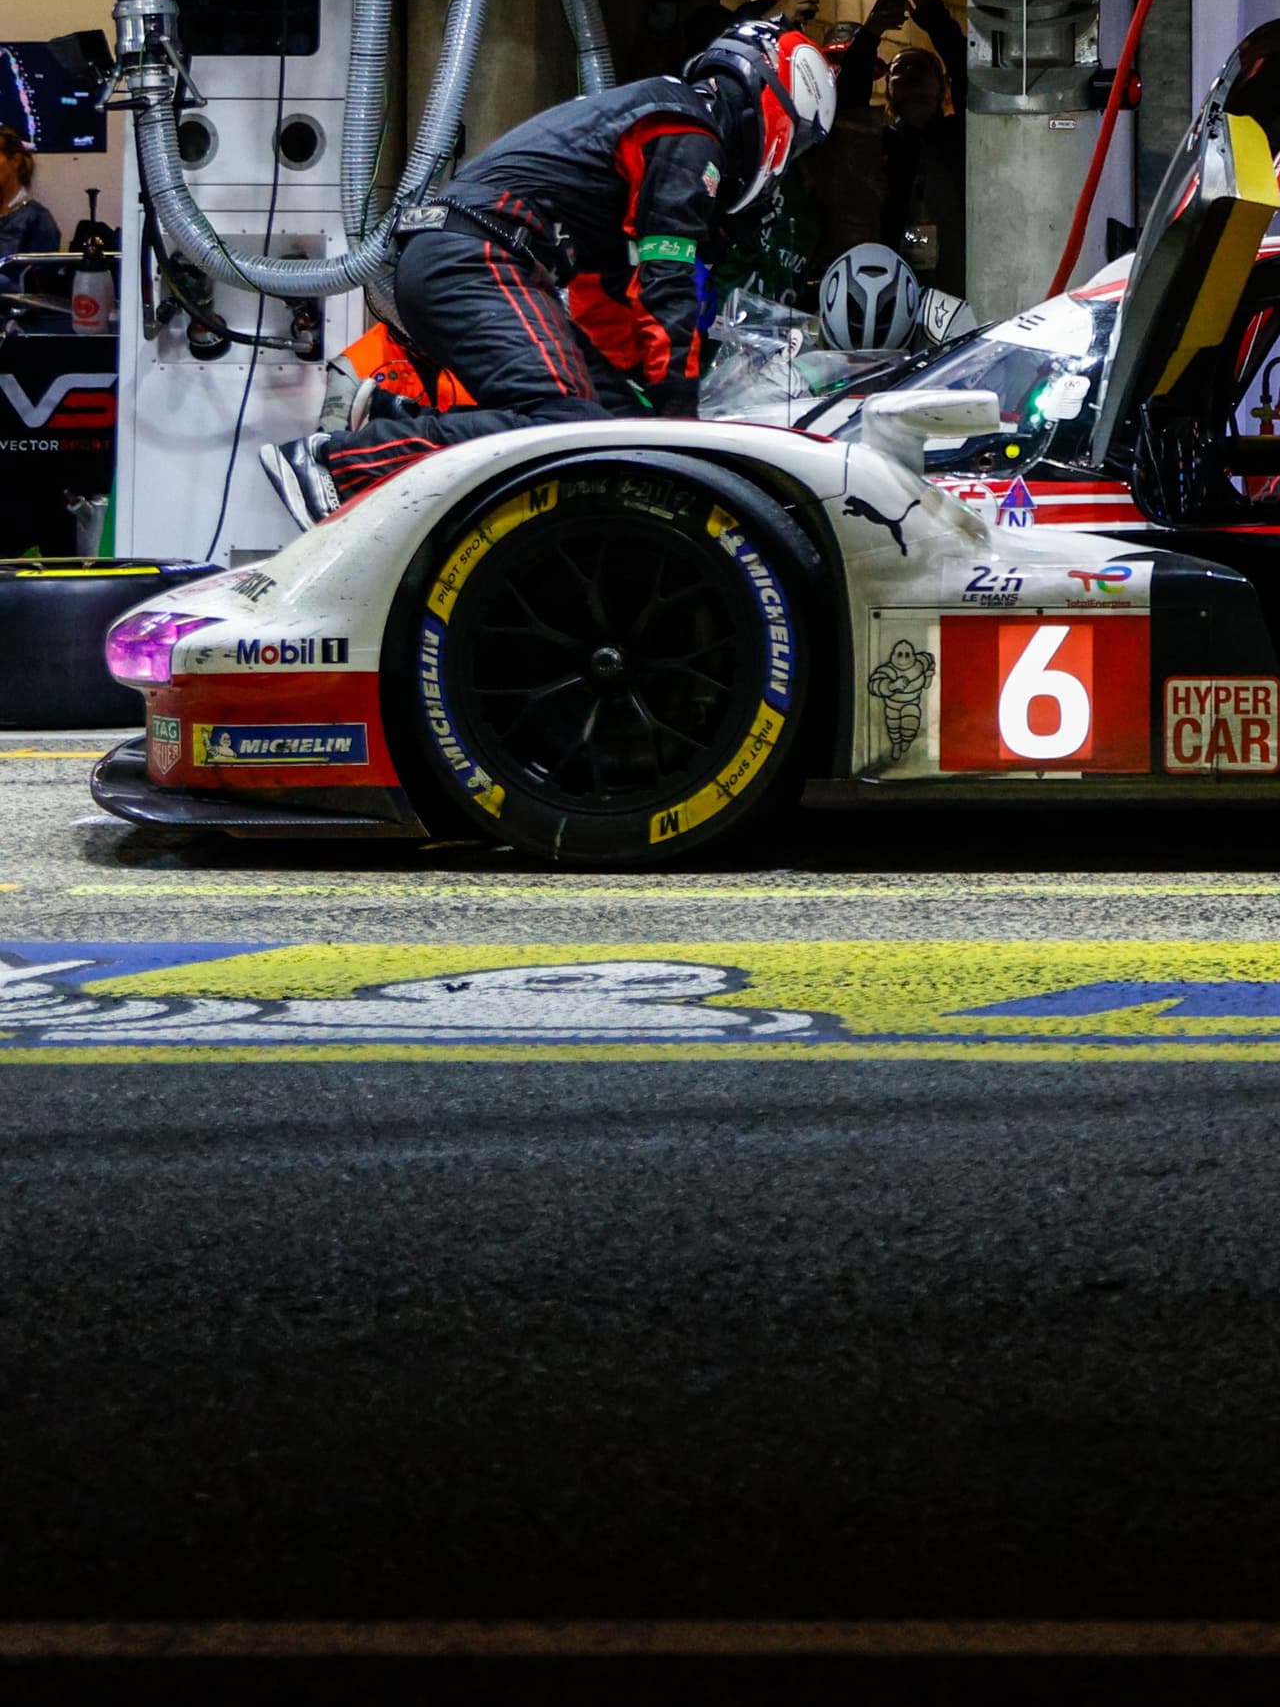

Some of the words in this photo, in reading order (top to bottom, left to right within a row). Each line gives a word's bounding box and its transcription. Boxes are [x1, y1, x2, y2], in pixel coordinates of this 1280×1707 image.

[437, 565, 461, 606] PILOT
[459, 524, 494, 566] SPORT
[962, 594, 977, 603] LE
[979, 593, 1018, 603] MANS
[1065, 598, 1132, 609] TotalEnergies
[739, 551, 791, 696] MICHELIN
[236, 638, 315, 665] Mobil
[421, 628, 472, 772] MICHELIN
[998, 625, 1092, 760] 6
[1172, 686, 1272, 715] HYPER
[153, 719, 178, 740] TAG
[239, 737, 353, 755] MICHELIN
[750, 719, 773, 761] PILOT
[1172, 717, 1272, 765] CAR
[715, 758, 751, 801] SPORT
[658, 810, 681, 838] M
